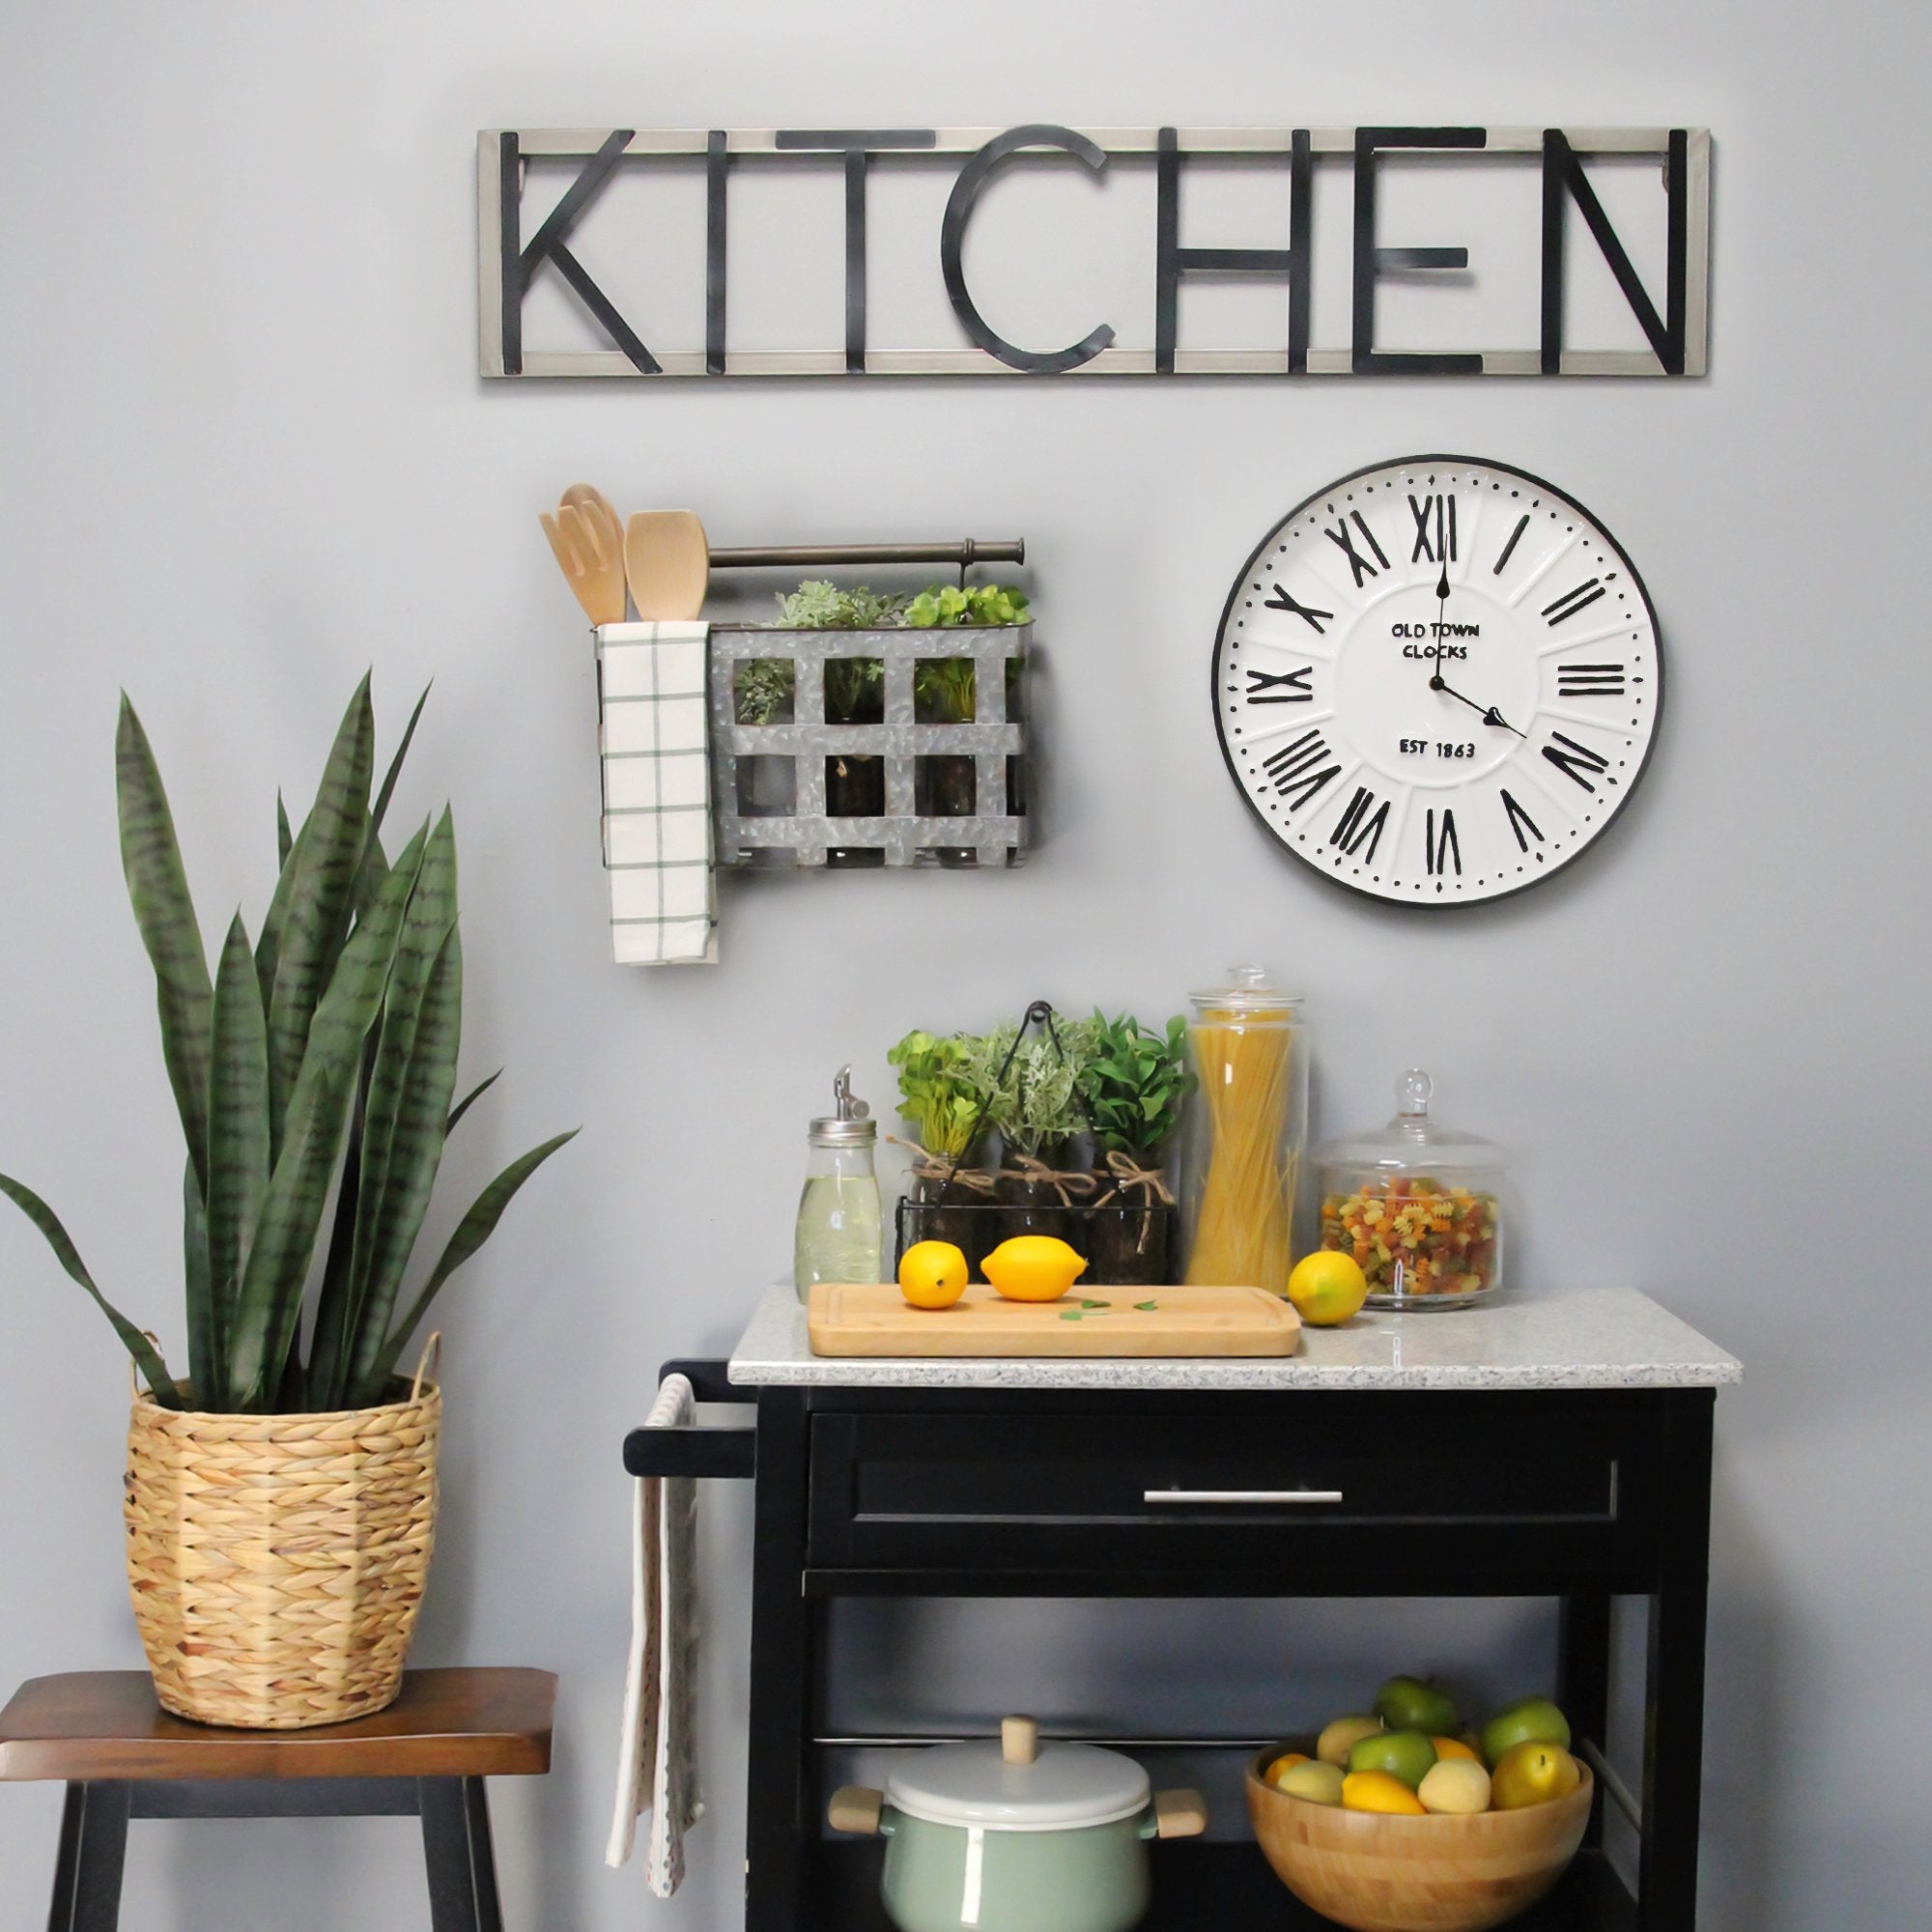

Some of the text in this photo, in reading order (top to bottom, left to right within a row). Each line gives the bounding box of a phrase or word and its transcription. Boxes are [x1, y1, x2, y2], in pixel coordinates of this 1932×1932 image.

[500, 125, 1688, 374] KITCHEN
[1324, 510, 1391, 587] XI
[1407, 494, 1457, 562] XII
[1264, 583, 1334, 634] X
[1391, 622, 1480, 638] OLD TOWN
[1542, 578, 1605, 626] II
[1403, 644, 1467, 660] CLOCKS
[1557, 664, 1625, 696] III
[1246, 666, 1313, 704] IX
[1263, 729, 1342, 811] VIII
[1400, 738, 1476, 758] EST 1863
[1542, 731, 1609, 793] IV
[1329, 786, 1391, 866] VII
[1427, 809, 1462, 875] VI
[1500, 788, 1545, 852] V
